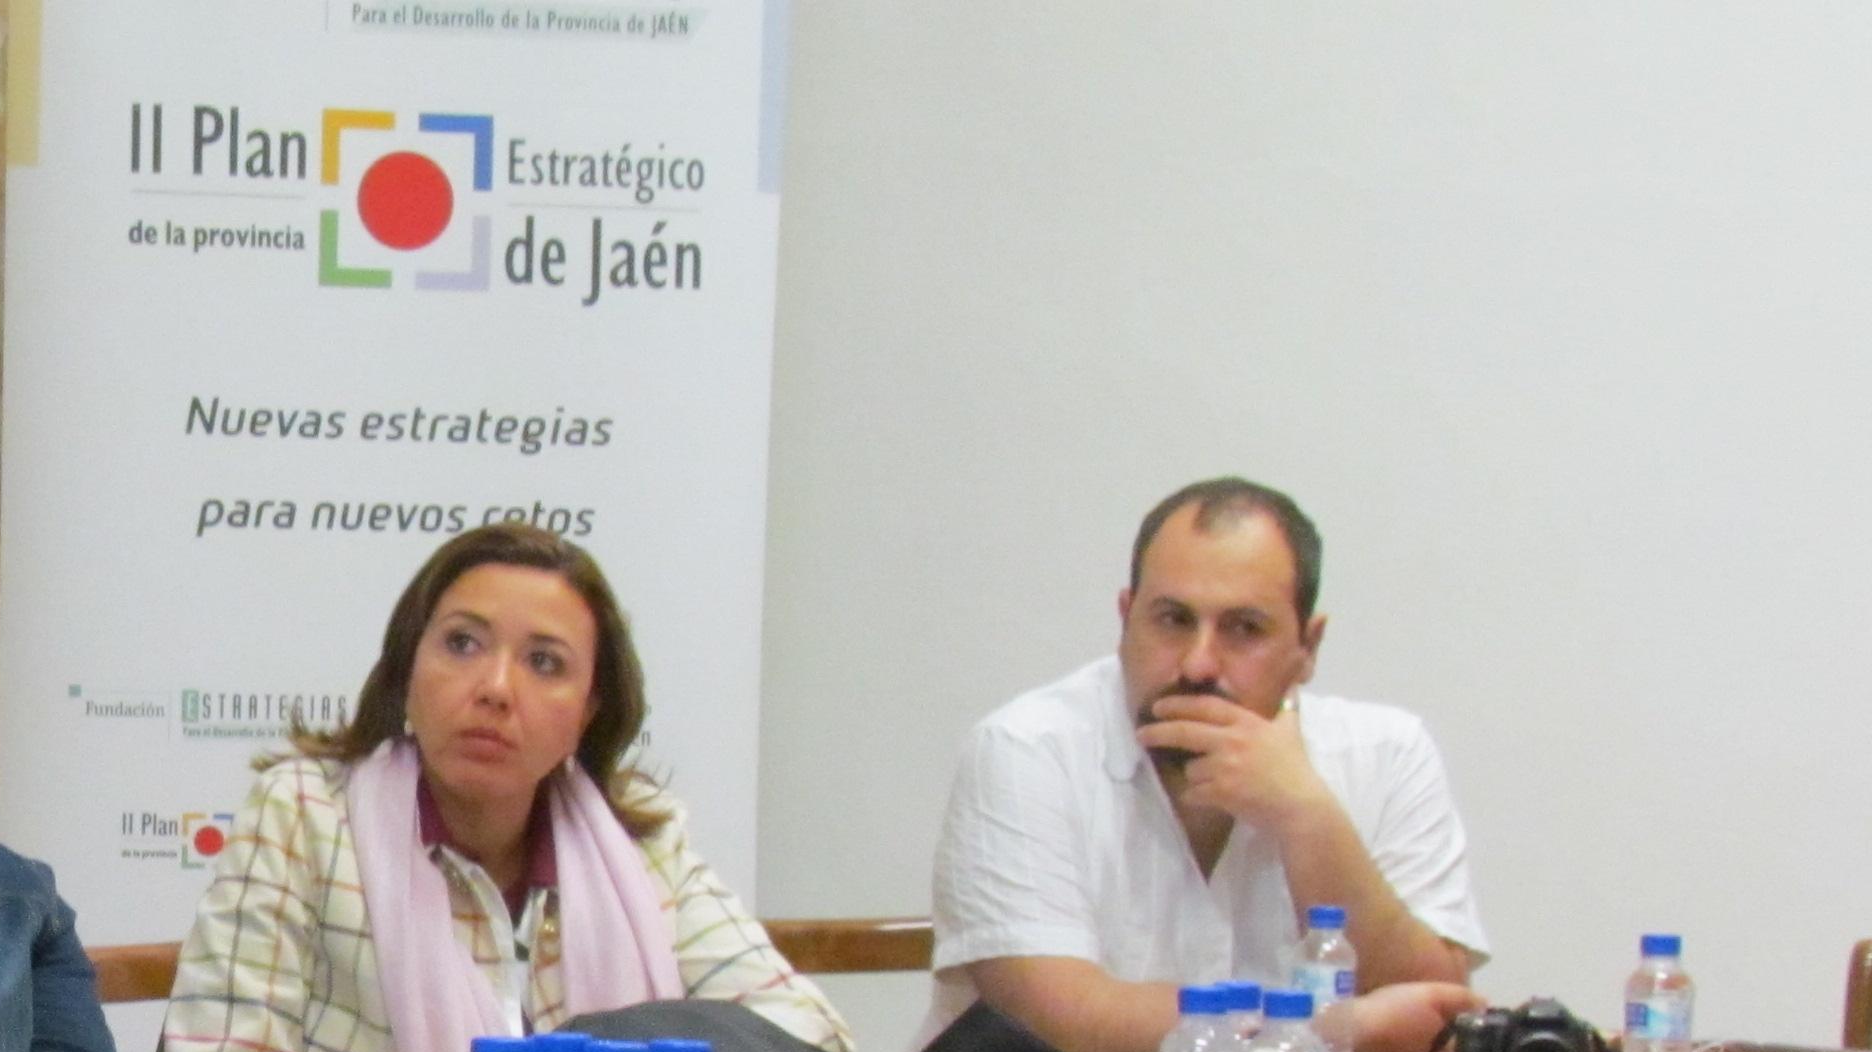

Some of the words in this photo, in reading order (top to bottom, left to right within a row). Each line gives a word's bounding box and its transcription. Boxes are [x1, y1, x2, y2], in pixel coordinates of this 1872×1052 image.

[352, 5, 386, 24] Para
[393, 7, 406, 24] el
[414, 8, 494, 28] Desarrollo
[501, 10, 519, 29] de
[526, 11, 540, 30] la
[547, 12, 621, 33] Provincia
[628, 14, 645, 33] de
[193, 105, 307, 180] Plan
[508, 138, 705, 203] Estratégico
[128, 220, 158, 244] de
[166, 221, 186, 246] la
[193, 223, 305, 252] provincia
[505, 215, 566, 286] de
[581, 217, 702, 306] Jaén
[186, 396, 346, 439] Nuevas
[360, 406, 614, 455] estrategias
[197, 498, 297, 537] para
[312, 501, 467, 533] nuevos
[85, 700, 165, 718] Fundación
[142, 812, 178, 836] Plan
